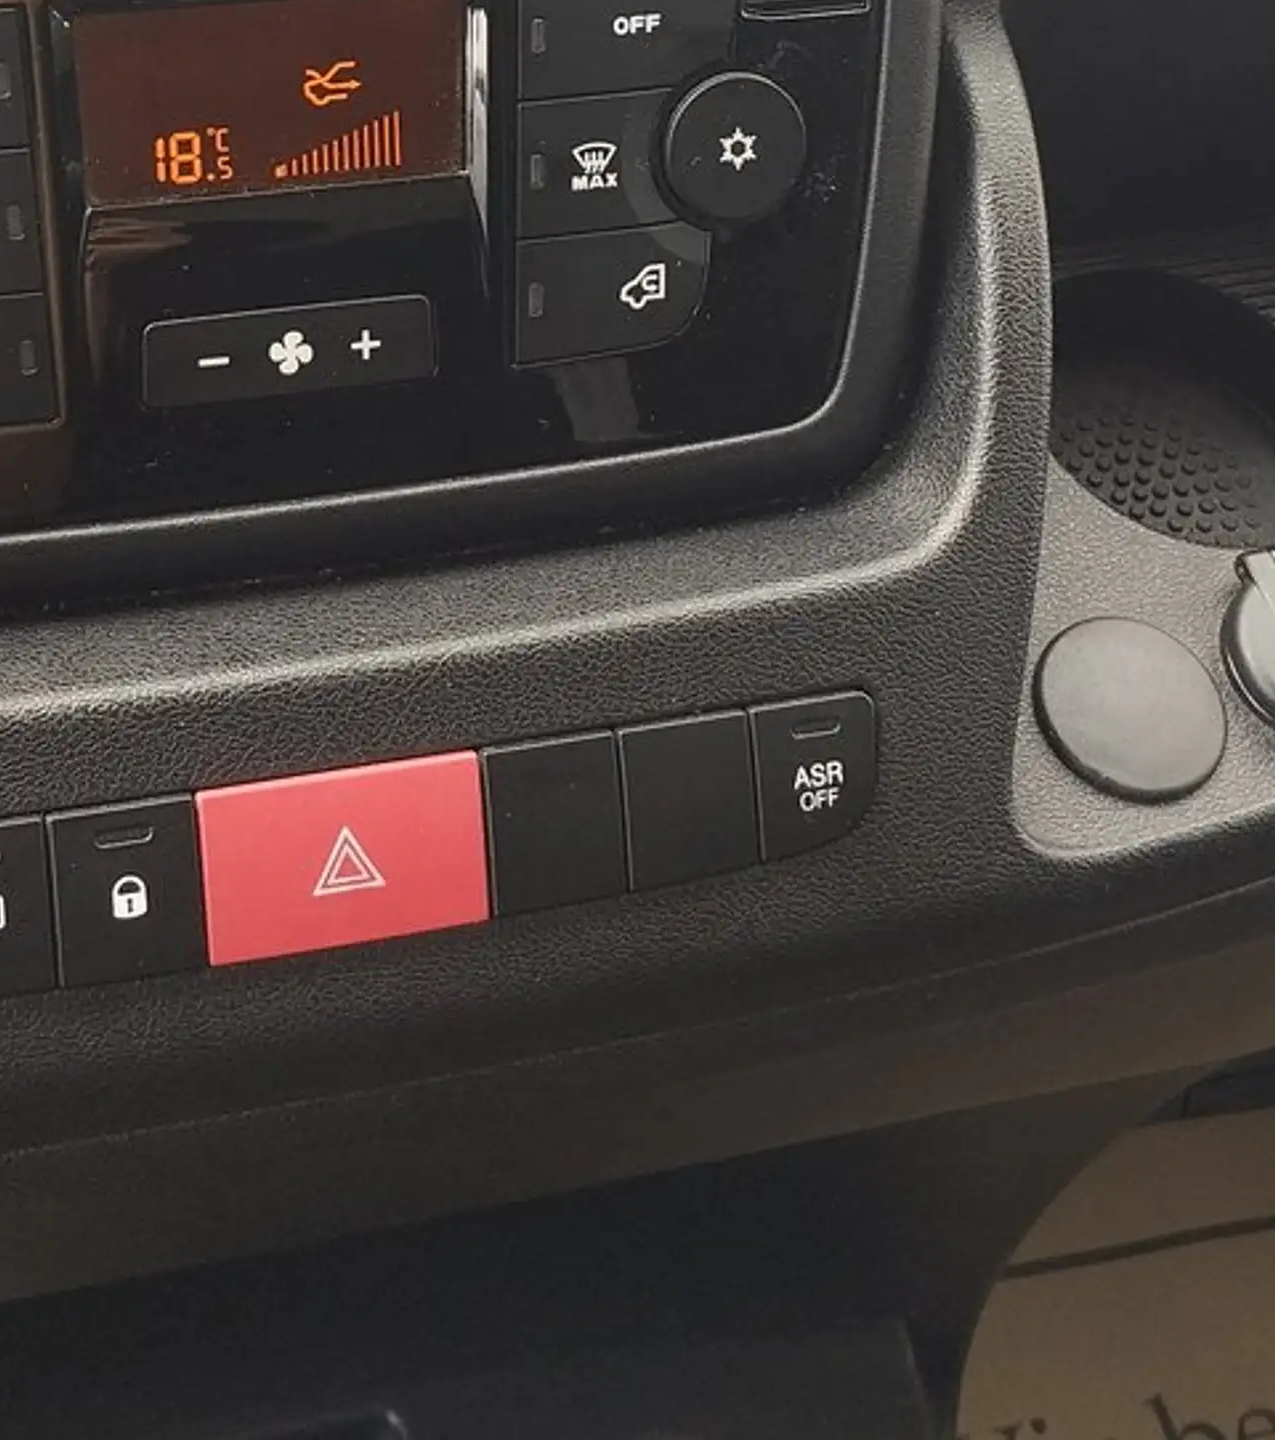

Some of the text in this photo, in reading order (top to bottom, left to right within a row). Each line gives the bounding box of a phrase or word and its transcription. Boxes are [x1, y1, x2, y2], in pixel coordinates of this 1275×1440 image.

[612, 13, 662, 37] OFF
[570, 172, 619, 192] MAX
[793, 759, 845, 791] ASR
[799, 786, 841, 812] OFF
